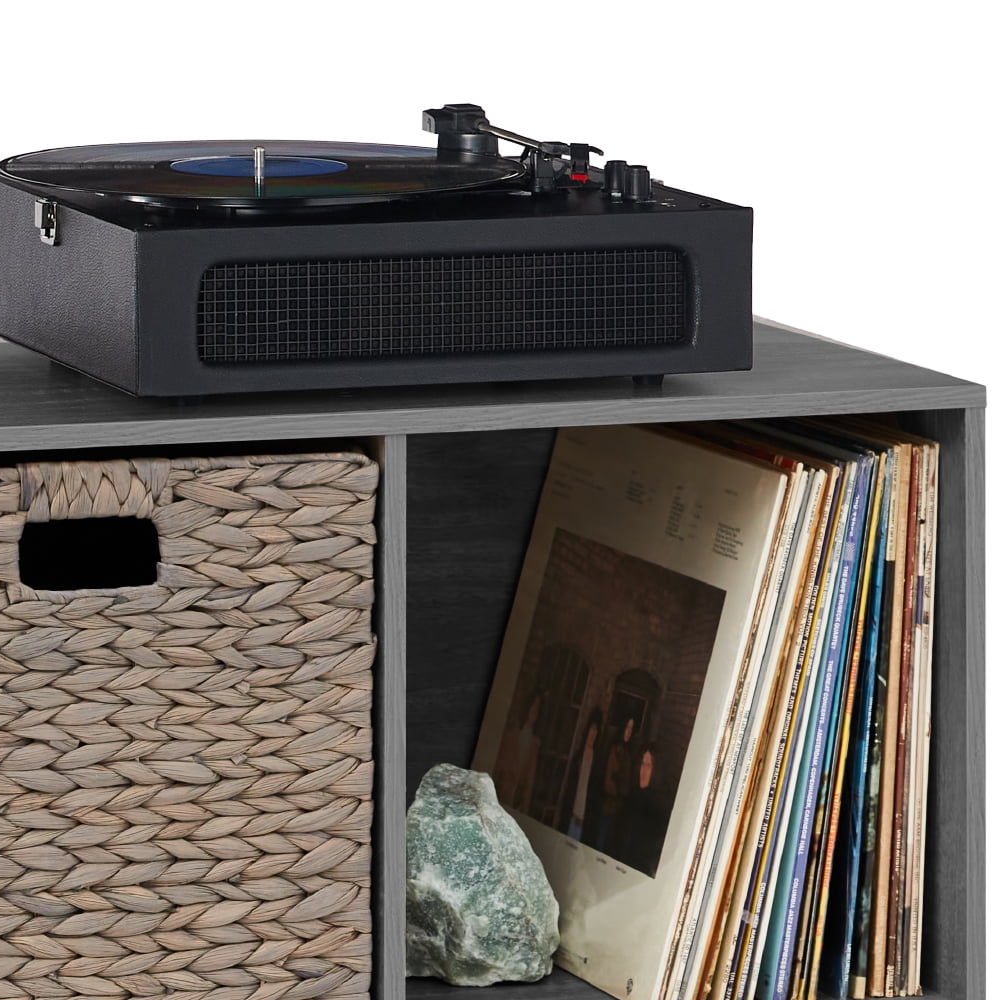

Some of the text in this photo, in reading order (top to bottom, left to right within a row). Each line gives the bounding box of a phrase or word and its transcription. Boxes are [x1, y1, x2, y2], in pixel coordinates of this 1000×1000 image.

[824, 494, 832, 506] THE
[820, 509, 828, 528] BEST
[817, 530, 824, 541] OF
[813, 544, 821, 557] THE
[808, 585, 818, 609] GOLDEN
[834, 593, 844, 621] BRUBECK
[802, 612, 813, 637] MOTION
[830, 622, 839, 649] QUARTET
[796, 639, 807, 665] PICTURE
[823, 672, 831, 691] GREAT
[786, 695, 795, 710] AND
[770, 742, 784, 788] SOUNDTRACKS
[805, 767, 816, 808] COPENHAGEN,
[763, 796, 773, 819] UNITED
[757, 822, 767, 848] ARTISTS
[800, 809, 810, 840] CARNEGIE
[797, 840, 805, 855] HALL
[789, 877, 799, 908] COLUMBIA
[779, 924, 792, 969] MASTERPIECES
[727, 971, 735, 985] UAL
[776, 969, 785, 992] STEREO
